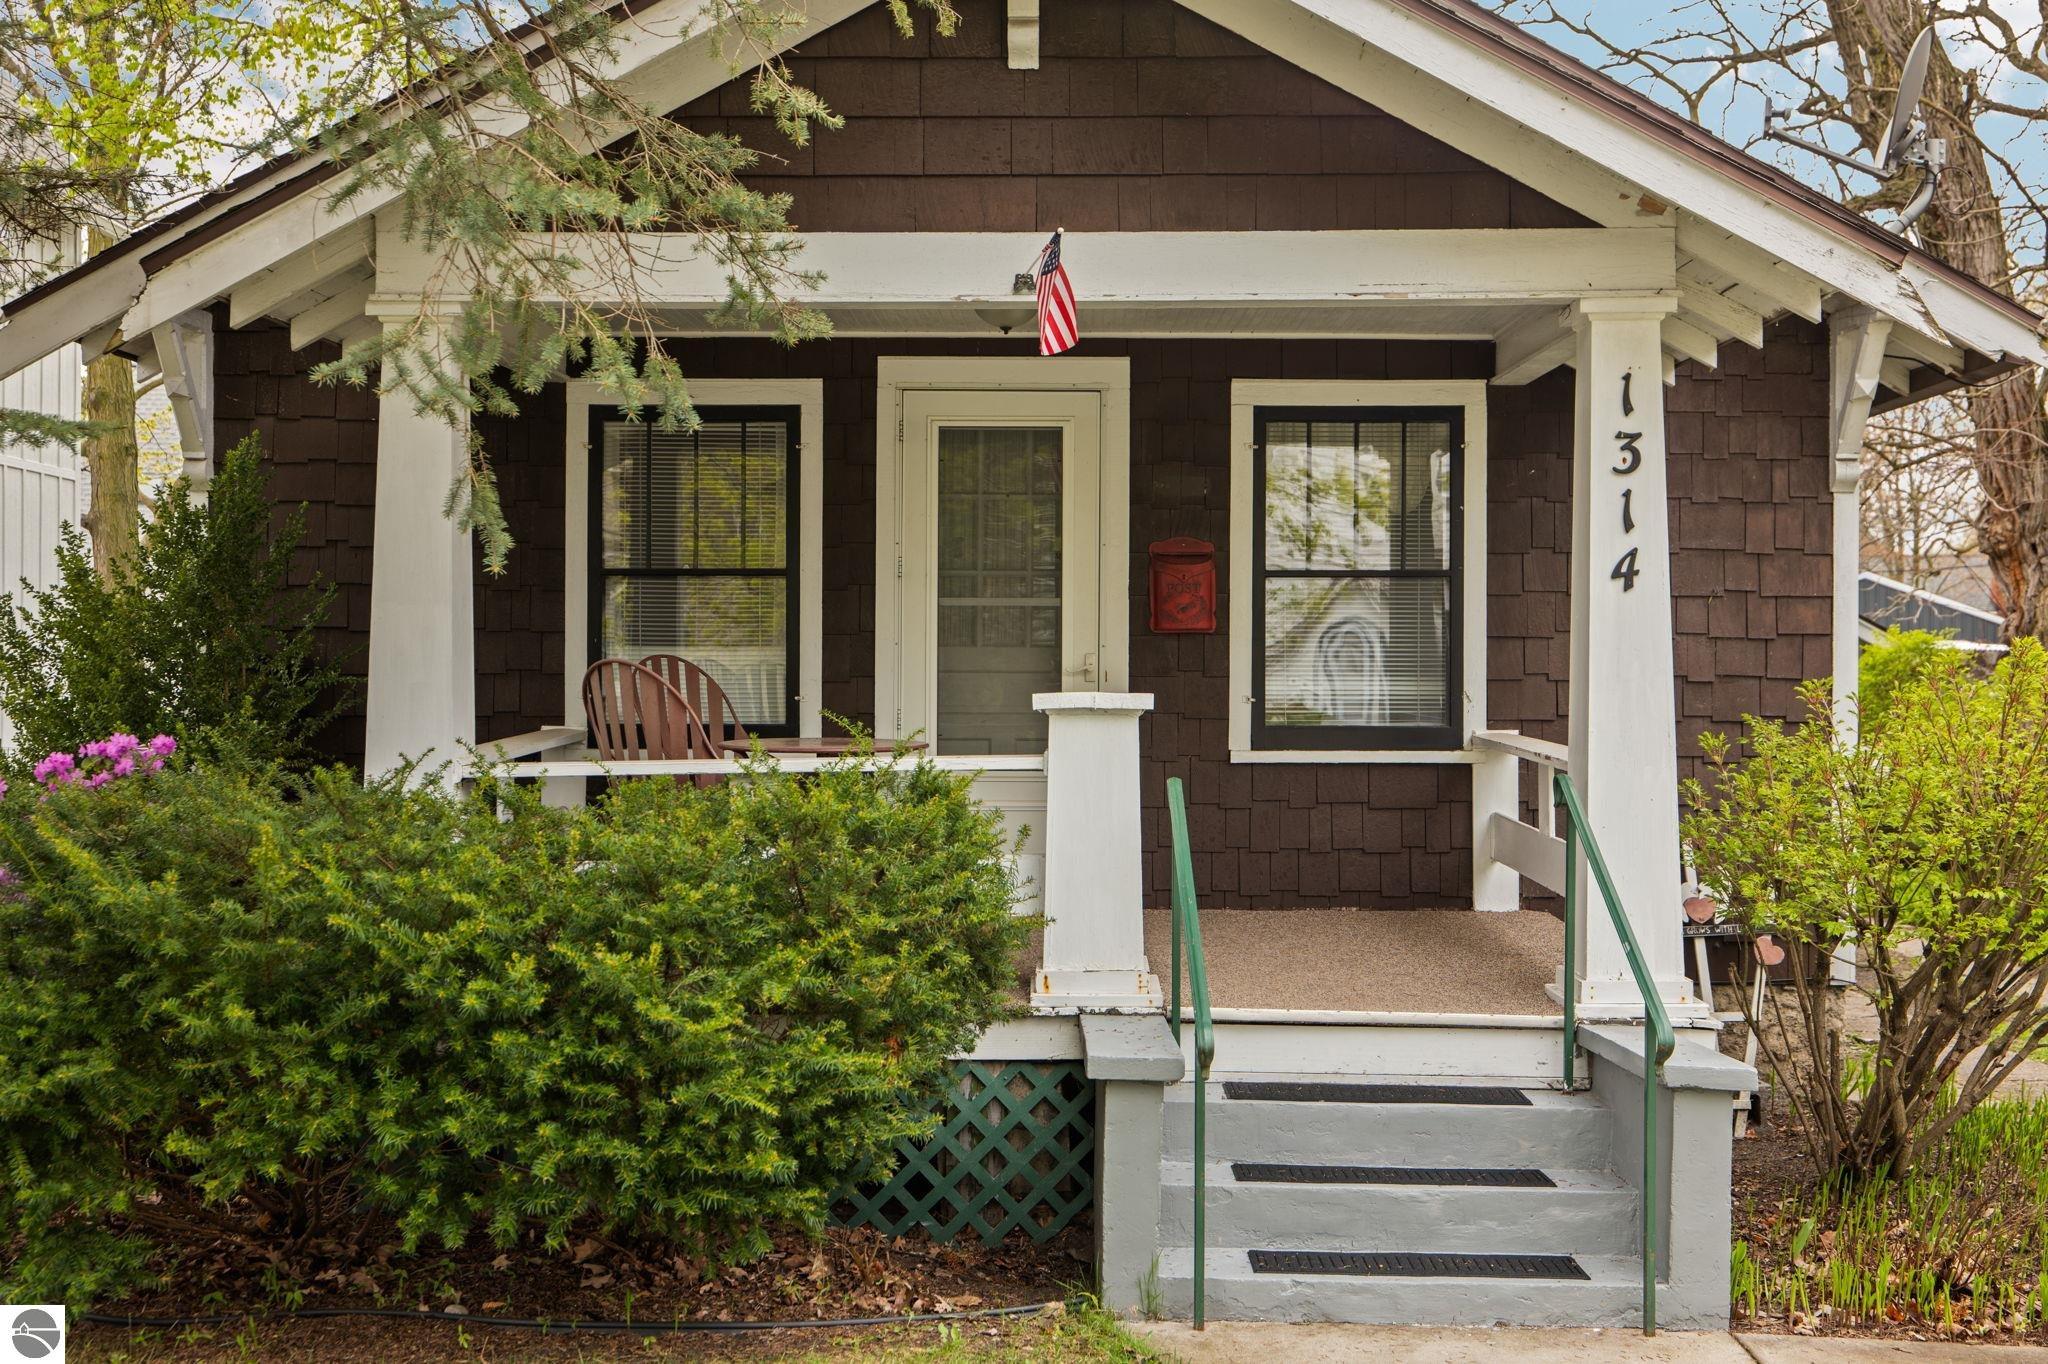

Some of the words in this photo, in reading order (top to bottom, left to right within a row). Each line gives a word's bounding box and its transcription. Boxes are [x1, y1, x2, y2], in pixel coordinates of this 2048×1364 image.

[1610, 371, 1643, 593] 1314
[1167, 583, 1201, 594] POST
[1686, 926, 1711, 935] GROWS
[1714, 925, 1733, 934] WITH
